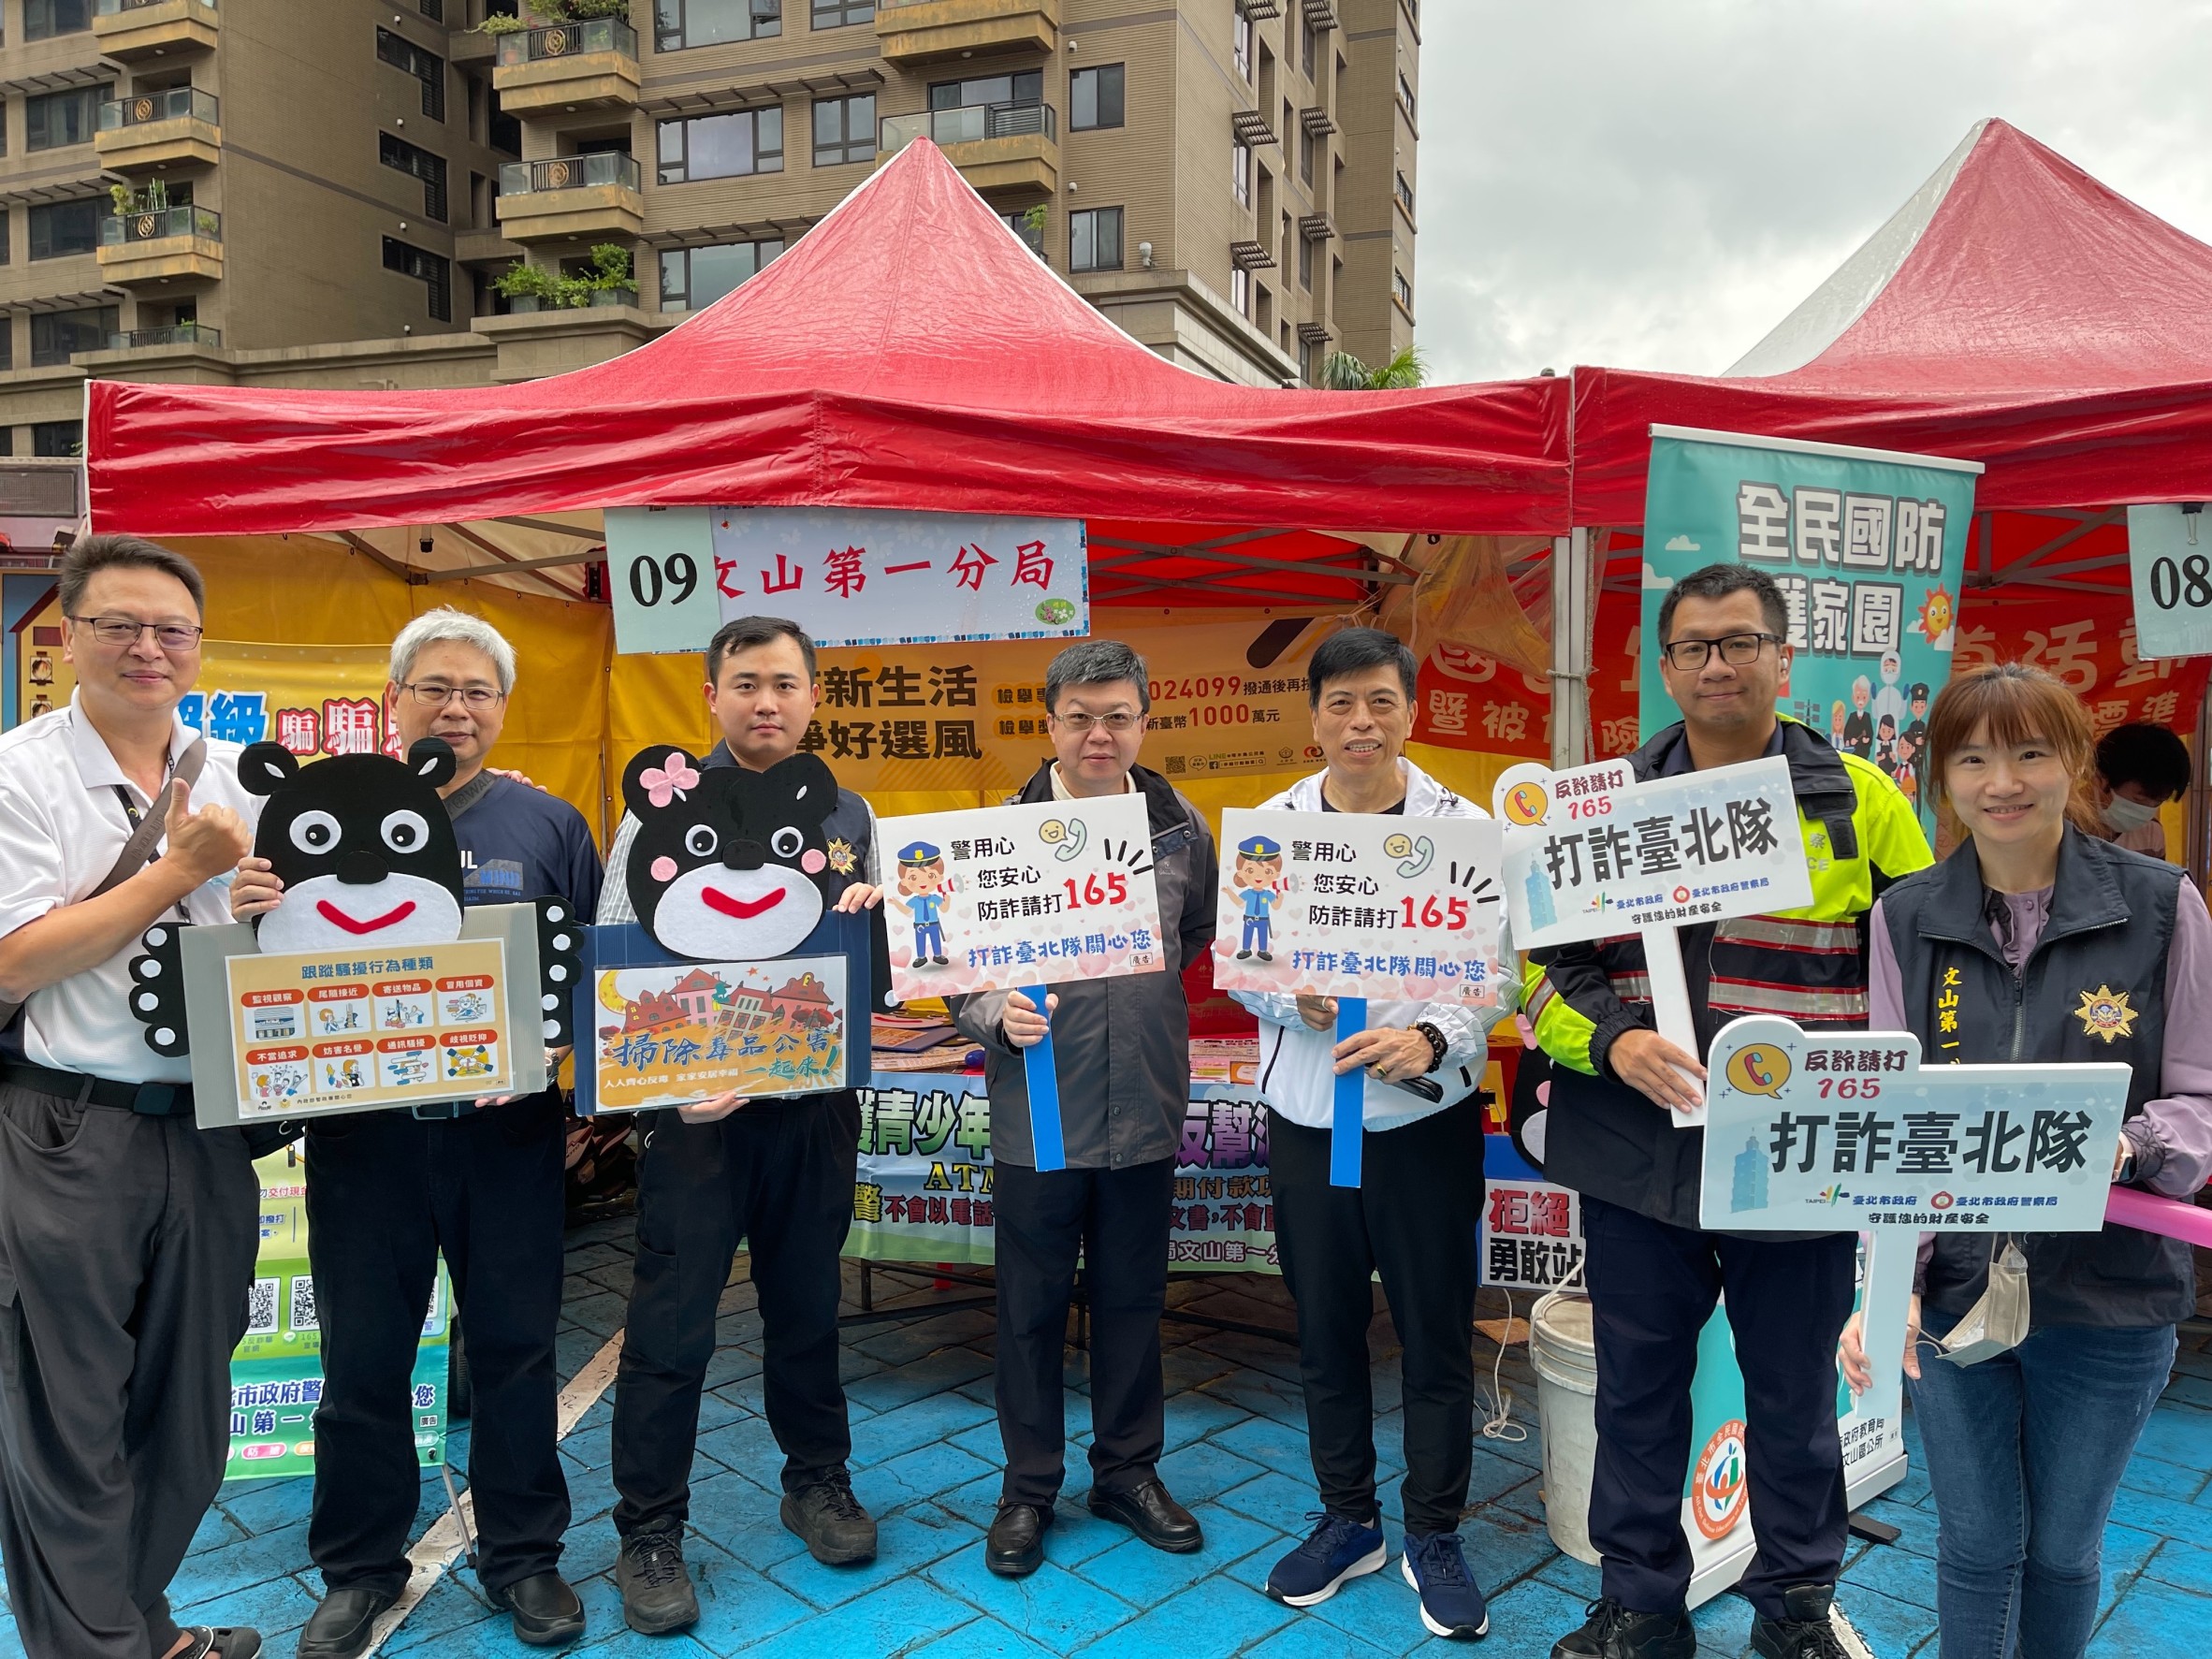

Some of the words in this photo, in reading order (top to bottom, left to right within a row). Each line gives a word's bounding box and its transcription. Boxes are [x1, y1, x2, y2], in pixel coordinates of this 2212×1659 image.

[1738, 482, 1946, 574] 全民國防
[629, 552, 697, 607] 09
[2151, 554, 2212, 610] 08
[815, 664, 977, 708] 新生活
[1567, 795, 1612, 820] 165
[951, 836, 1015, 861] 警用心
[1291, 840, 1357, 863] 警用心
[1544, 796, 1779, 890] 打詐臺北隊
[977, 865, 1041, 890] 您安心
[1313, 873, 1379, 895] 您安心
[968, 928, 1152, 968] 打詐臺北隊關心您
[1131, 954, 1152, 967] 廣告
[301, 956, 433, 980] 跟蹤騷擾行為種類
[1292, 950, 1486, 982] 打詐臺北隊關心您
[252, 993, 293, 1005] 監視觀察
[318, 987, 358, 999] 尾隨接近
[383, 982, 421, 993] 寄送物品
[1462, 986, 1482, 997] 廣告
[1938, 967, 1962, 1064] 文山第一
[256, 1049, 298, 1062] 不當追求
[323, 1043, 363, 1056] 妨害名譽
[386, 1038, 426, 1051] 通訊騷擾
[449, 1032, 488, 1044] 歧視貶抑
[612, 1028, 831, 1072] 掃除毒品公害
[1817, 1077, 1882, 1099] 165
[1769, 1110, 2093, 1175] 打詐臺北隊
[1488, 1188, 1570, 1238] 拒絕
[1489, 1237, 1583, 1288] 勇敢站
[230, 1409, 315, 1434] 山第一
[420, 1417, 438, 1426] 廣告
